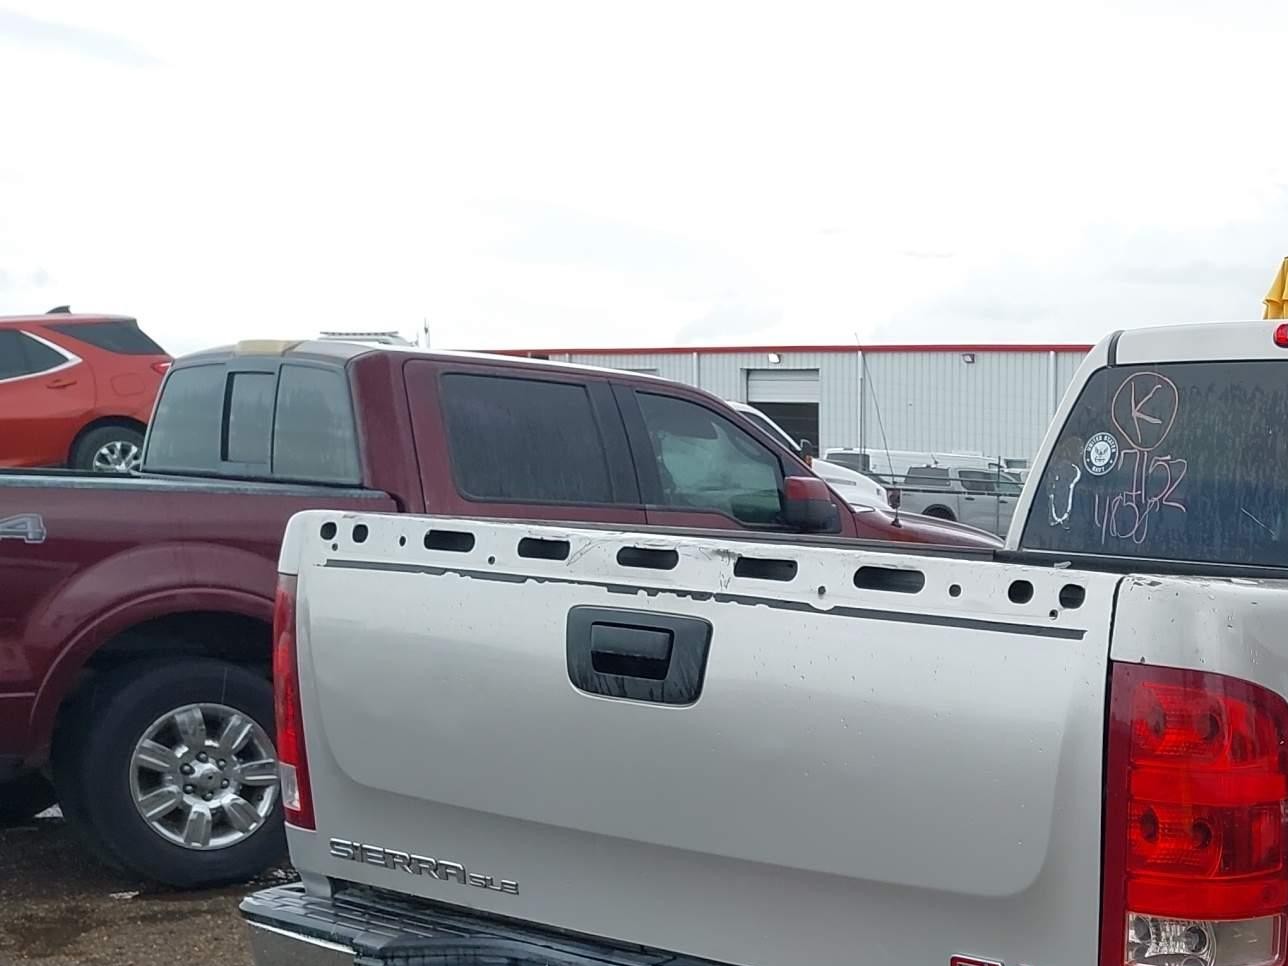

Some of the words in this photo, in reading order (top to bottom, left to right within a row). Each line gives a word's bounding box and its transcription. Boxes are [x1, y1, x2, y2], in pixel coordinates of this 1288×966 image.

[1131, 381, 1162, 444] K
[329, 837, 467, 885] SIERRA
[469, 872, 520, 896] SLE
